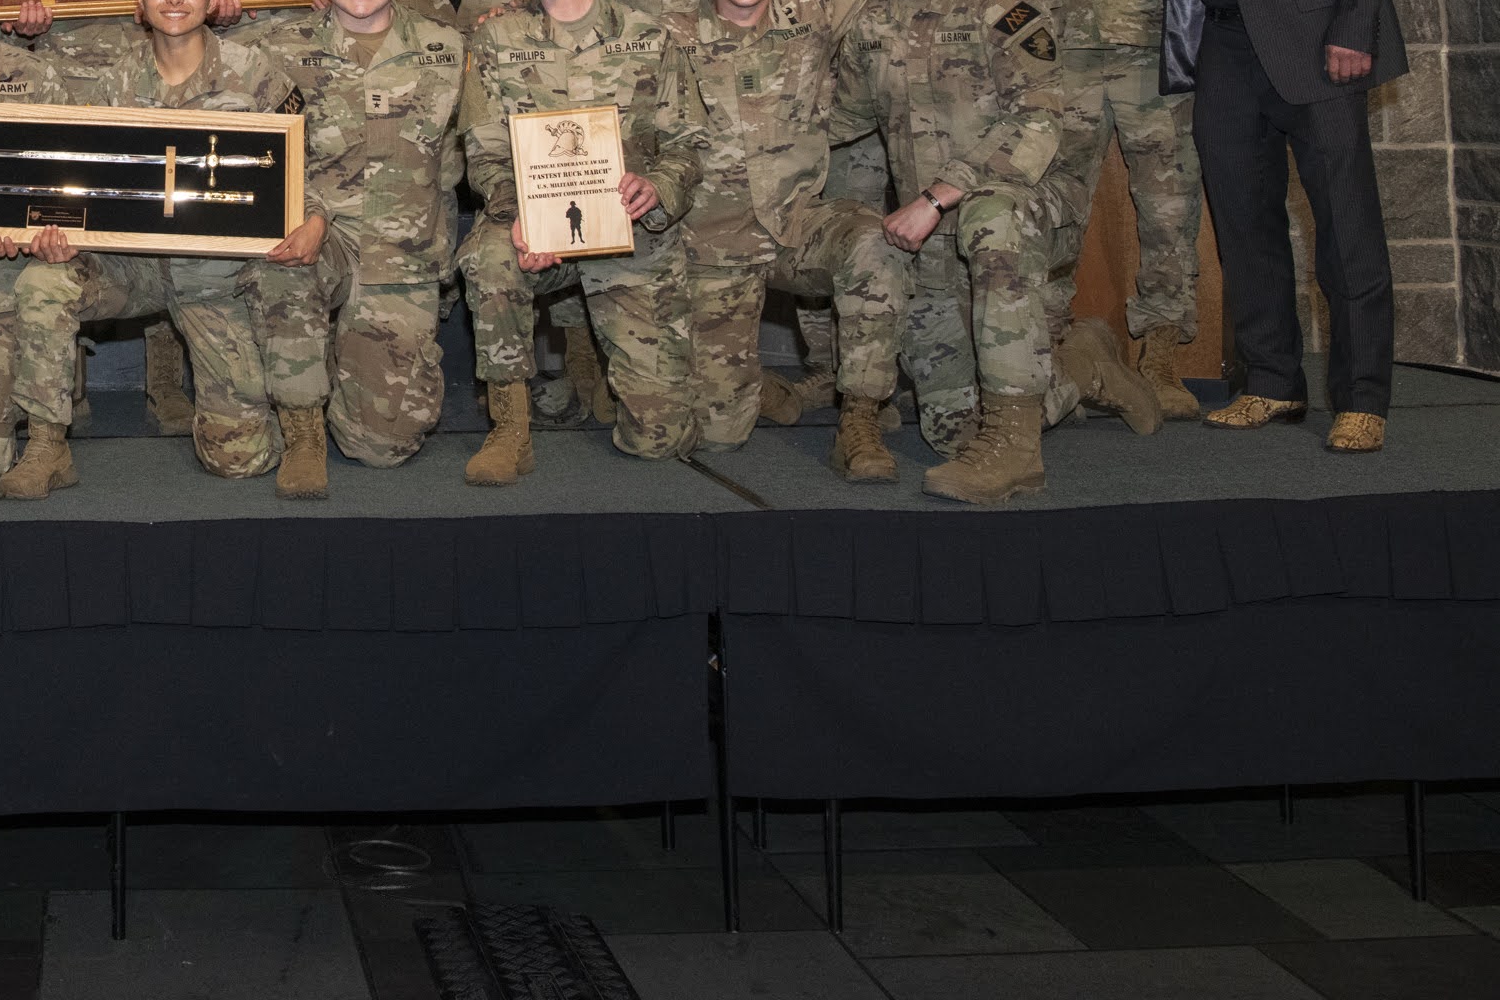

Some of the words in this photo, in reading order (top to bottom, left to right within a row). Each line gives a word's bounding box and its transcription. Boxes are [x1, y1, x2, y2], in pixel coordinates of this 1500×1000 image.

[509, 51, 545, 61] PHILLIPS
[302, 57, 323, 66] WEST
[0, 82, 28, 92] ARMY
[529, 163, 556, 171] PHYSICAL
[556, 160, 589, 168] ENDURANCE
[563, 170, 582, 178] RUCK
[579, 178, 605, 186] ACADEMY
[527, 191, 562, 199] SANDHURST
[563, 188, 603, 197] COMPETITION
